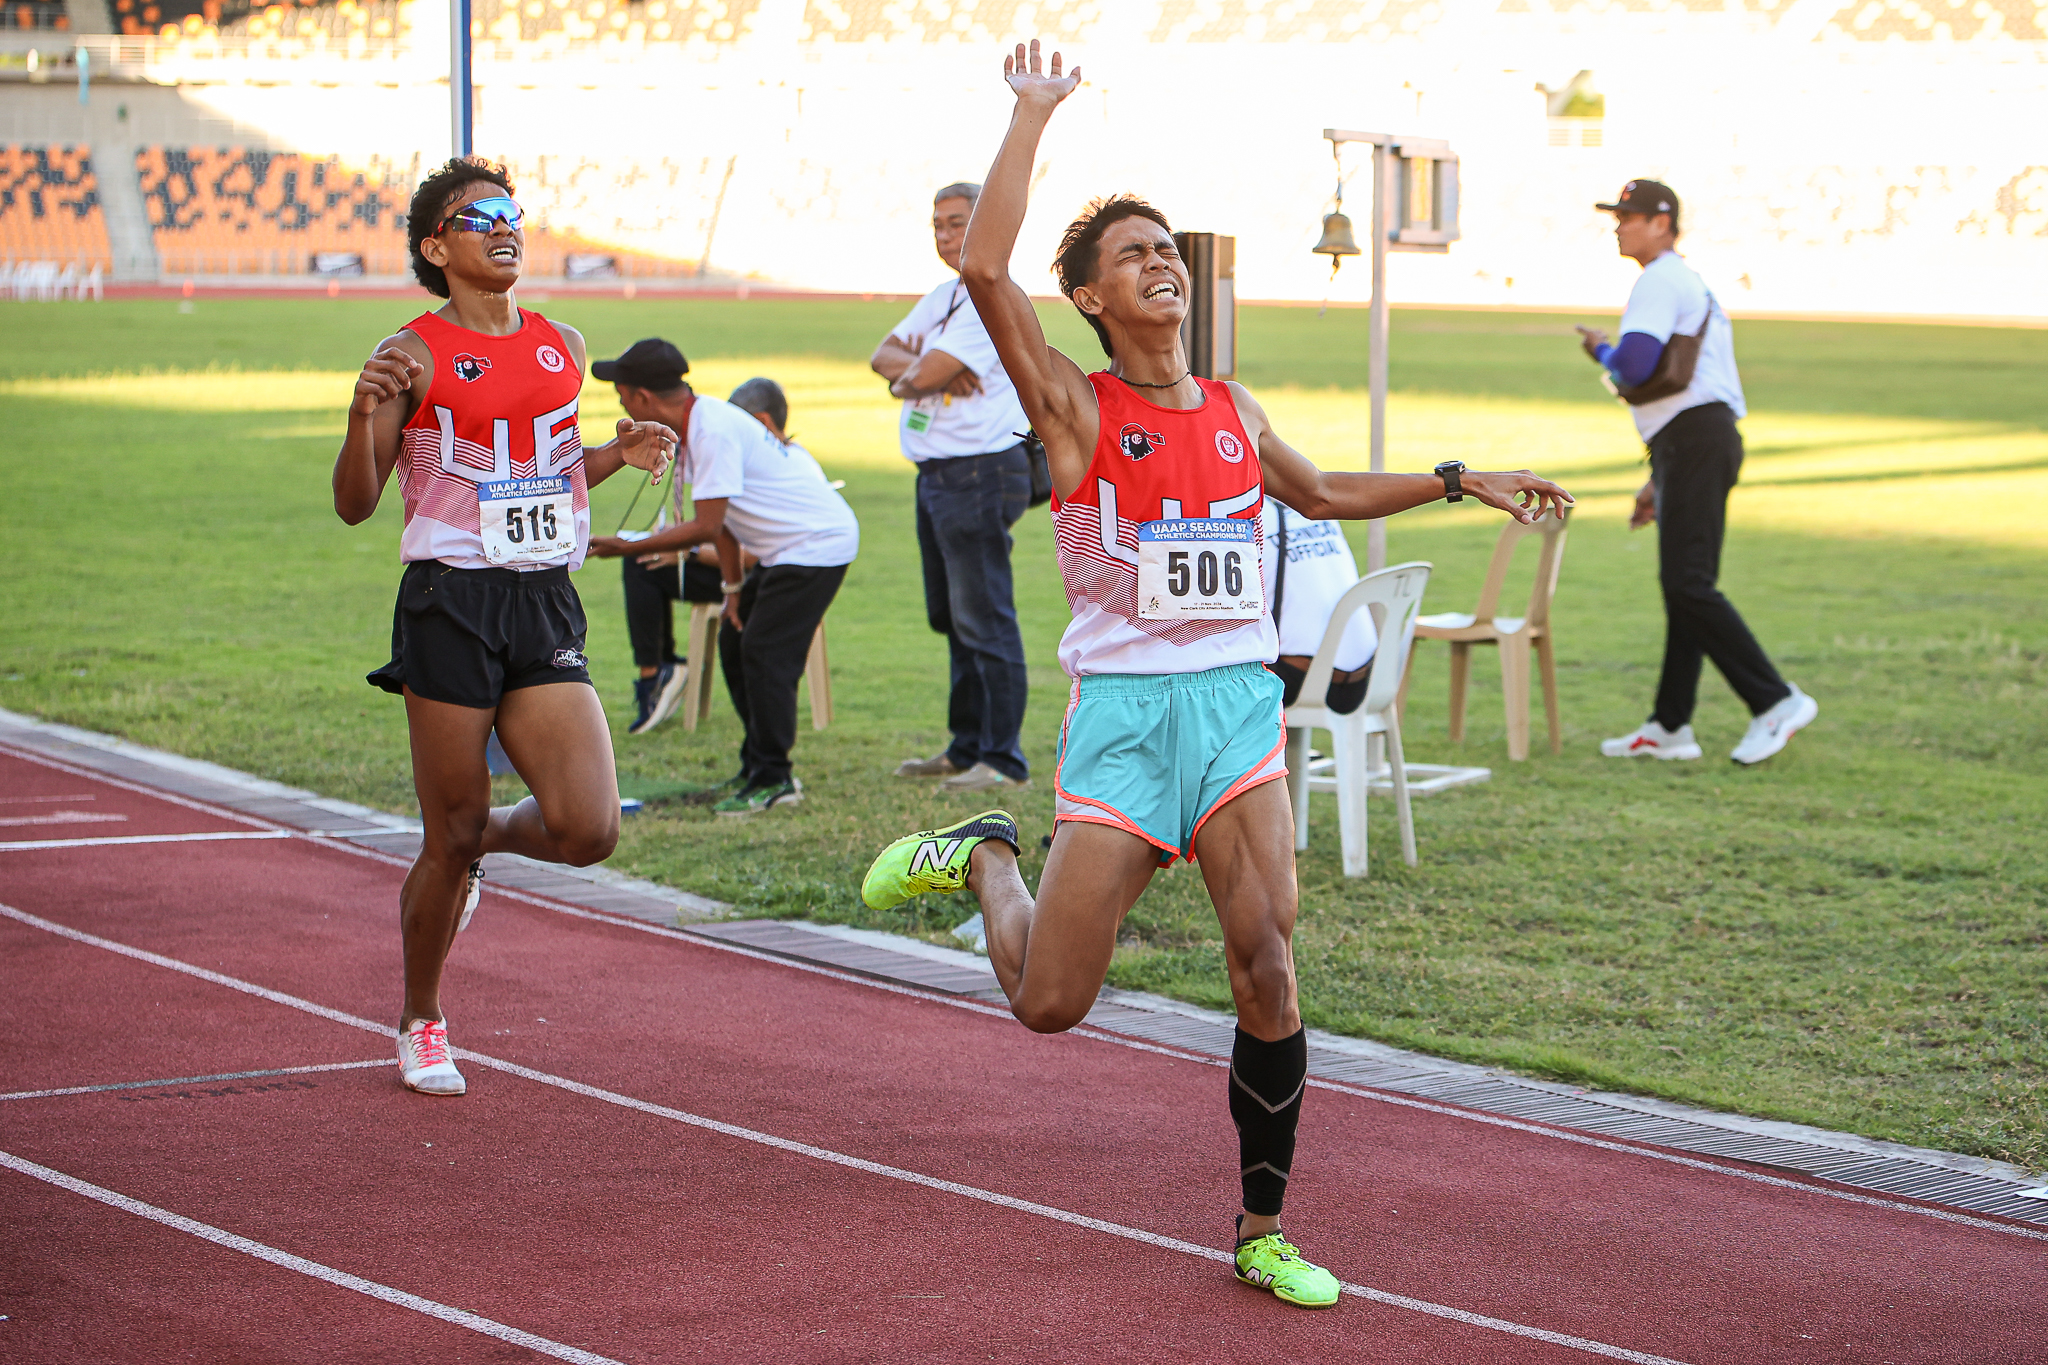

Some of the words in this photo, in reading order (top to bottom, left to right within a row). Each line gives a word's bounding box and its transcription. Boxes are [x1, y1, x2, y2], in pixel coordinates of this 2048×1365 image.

[433, 395, 583, 484] UE
[489, 482, 517, 493] UAAP
[519, 479, 554, 491] SEASON
[491, 490, 523, 499] ATHLETICS
[523, 487, 564, 496] CHAMPIONSHIPS
[506, 503, 558, 544] 515
[1150, 523, 1187, 534] UAAP
[1189, 522, 1234, 533] SEASON
[1235, 523, 1246, 534] 87
[1154, 532, 1197, 540] ATHLETICS
[1195, 532, 1248, 540] CHAMPIONSHIPS
[1167, 551, 1243, 597] 506
